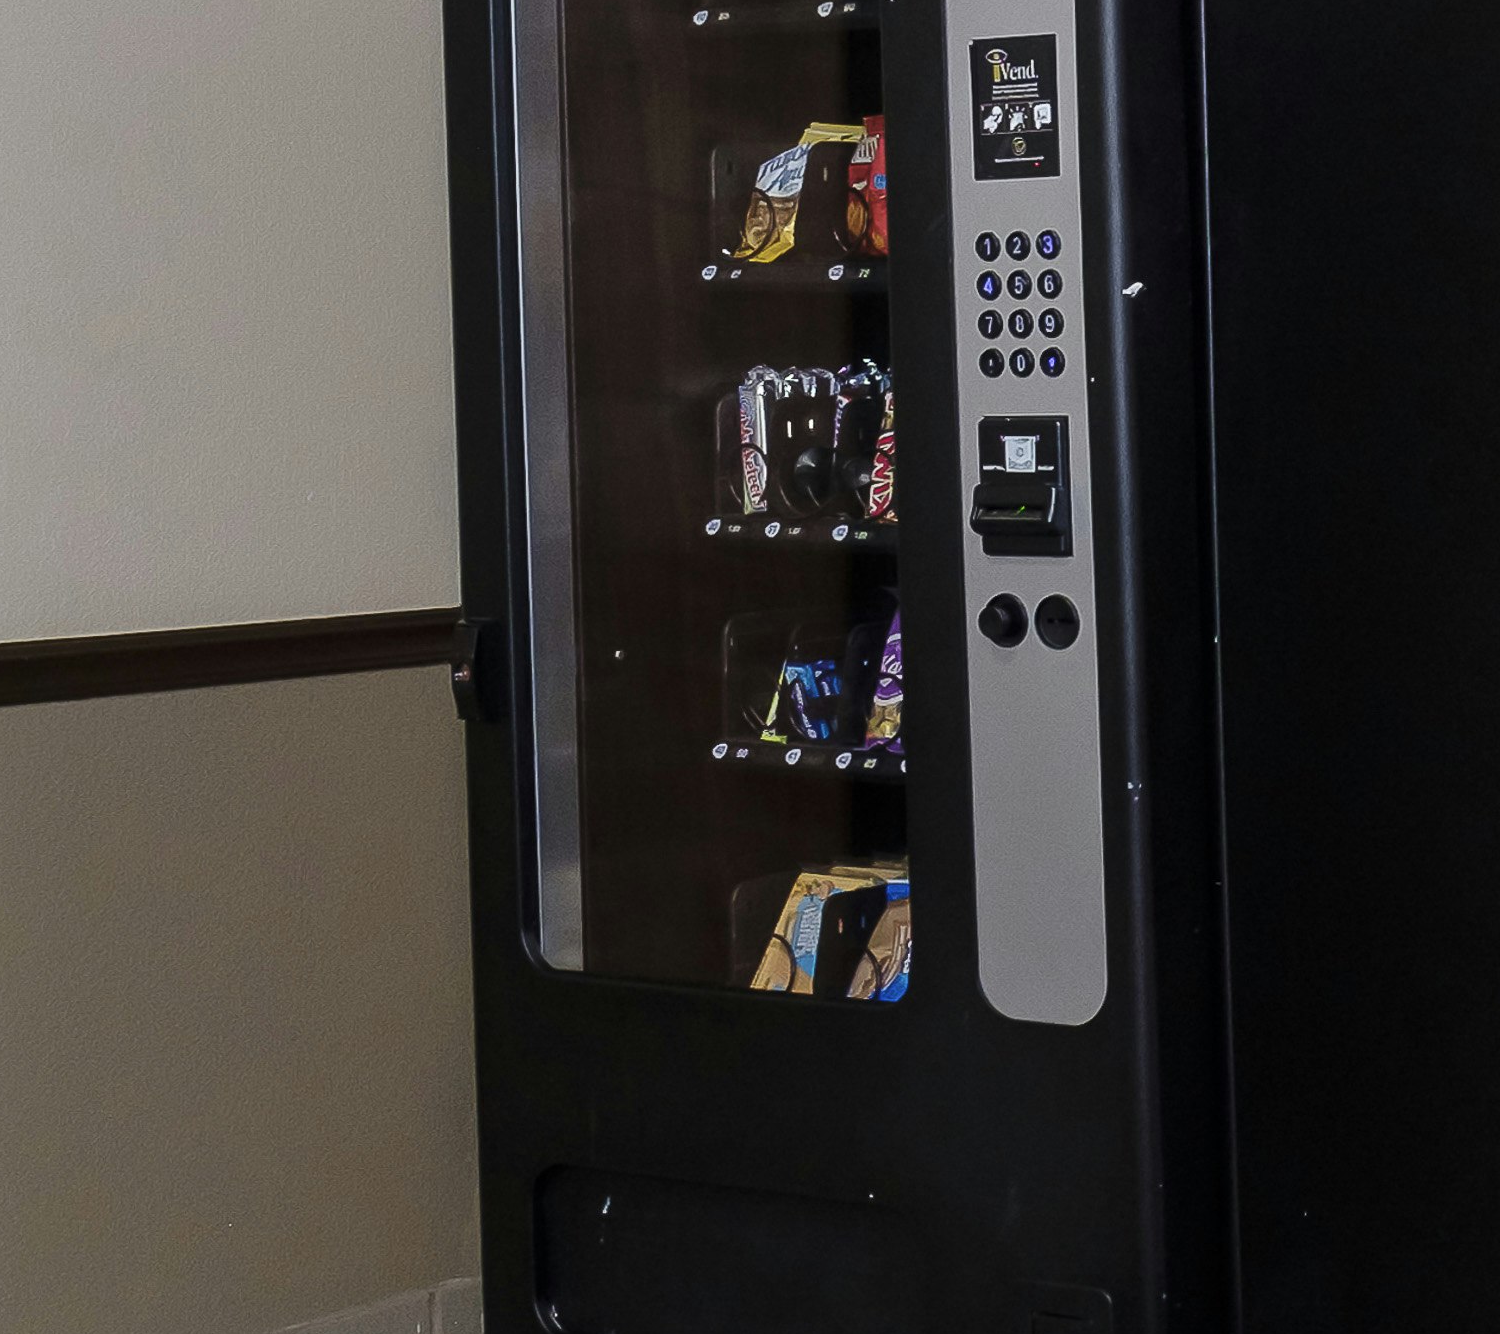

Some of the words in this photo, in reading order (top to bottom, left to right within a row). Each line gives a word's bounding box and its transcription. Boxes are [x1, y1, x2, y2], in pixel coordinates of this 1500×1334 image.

[983, 238, 991, 255] 1
[1013, 237, 1021, 254] 2
[1043, 235, 1053, 254] 3
[983, 277, 993, 294] 4
[1014, 276, 1023, 294] 5
[1044, 275, 1054, 293] 6
[985, 316, 993, 334] 7
[1015, 315, 1024, 332] 8
[1045, 315, 1055, 333] 9
[1016, 354, 1025, 372] 0
